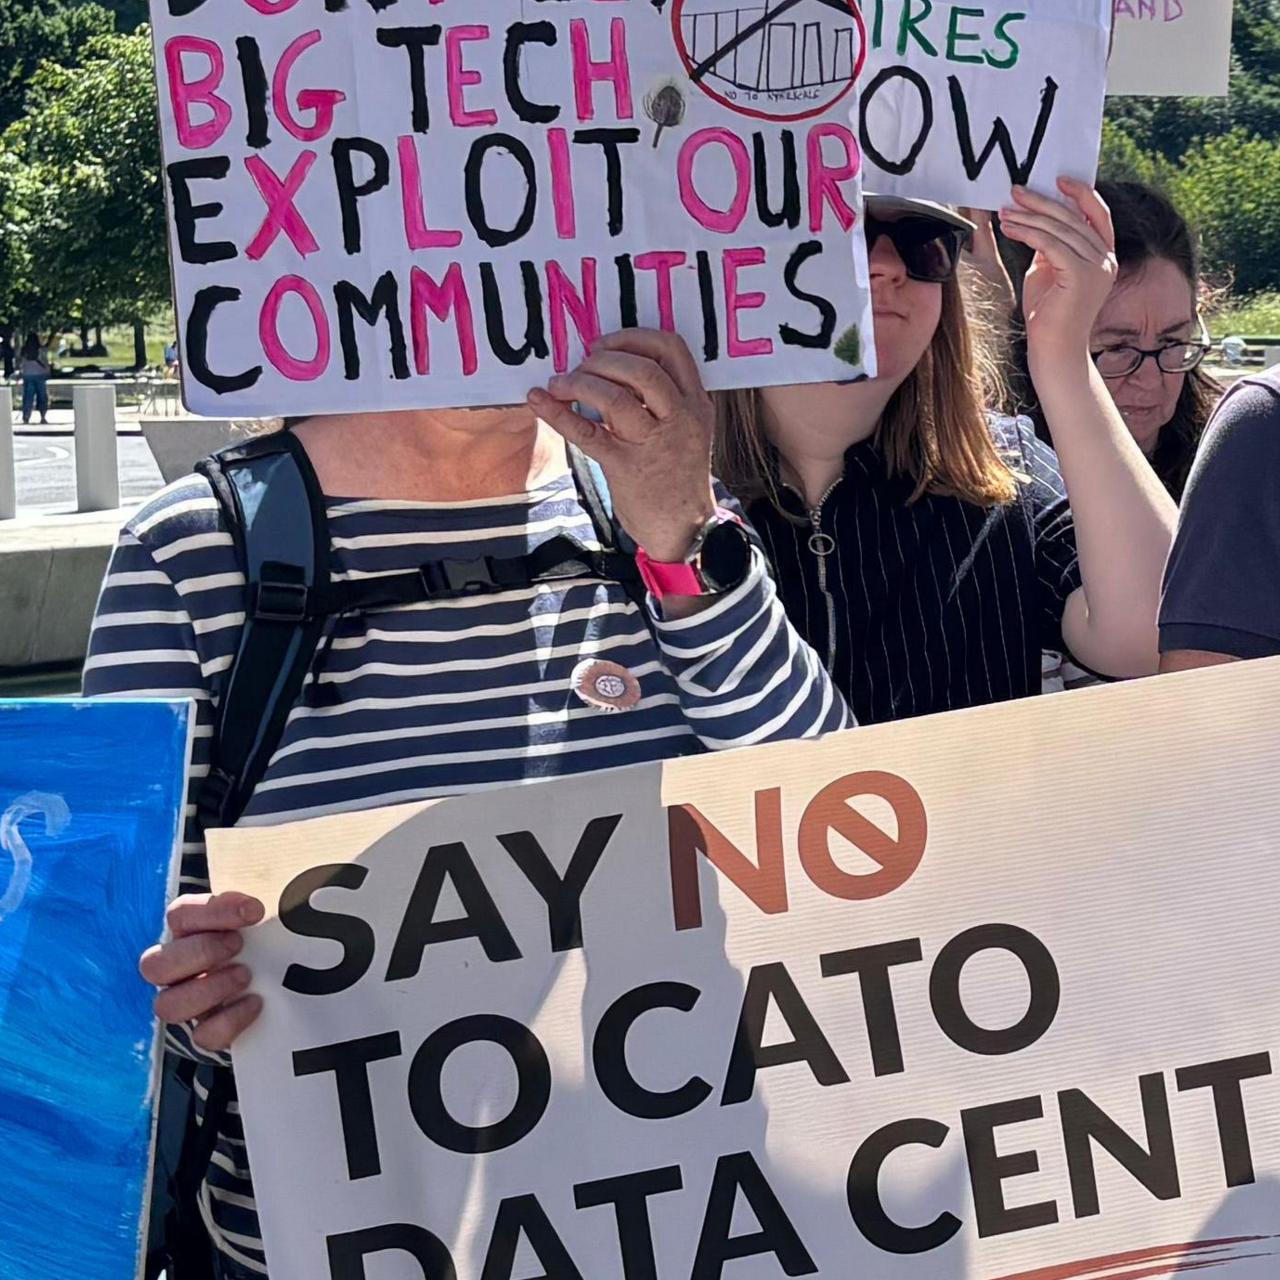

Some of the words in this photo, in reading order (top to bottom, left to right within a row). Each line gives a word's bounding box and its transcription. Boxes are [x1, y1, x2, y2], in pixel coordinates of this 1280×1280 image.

[163, 29, 347, 150] BIG
[376, 16, 634, 134] TECH
[858, 64, 1058, 187] OW
[166, 127, 640, 265] EXPLOIT
[676, 122, 861, 235] OUR
[184, 240, 839, 395] COMMUNITIES
[277, 813, 624, 996] SAY
[667, 769, 928, 932] NO
[291, 1012, 552, 1181] TO
[592, 922, 1062, 1120] CATO
